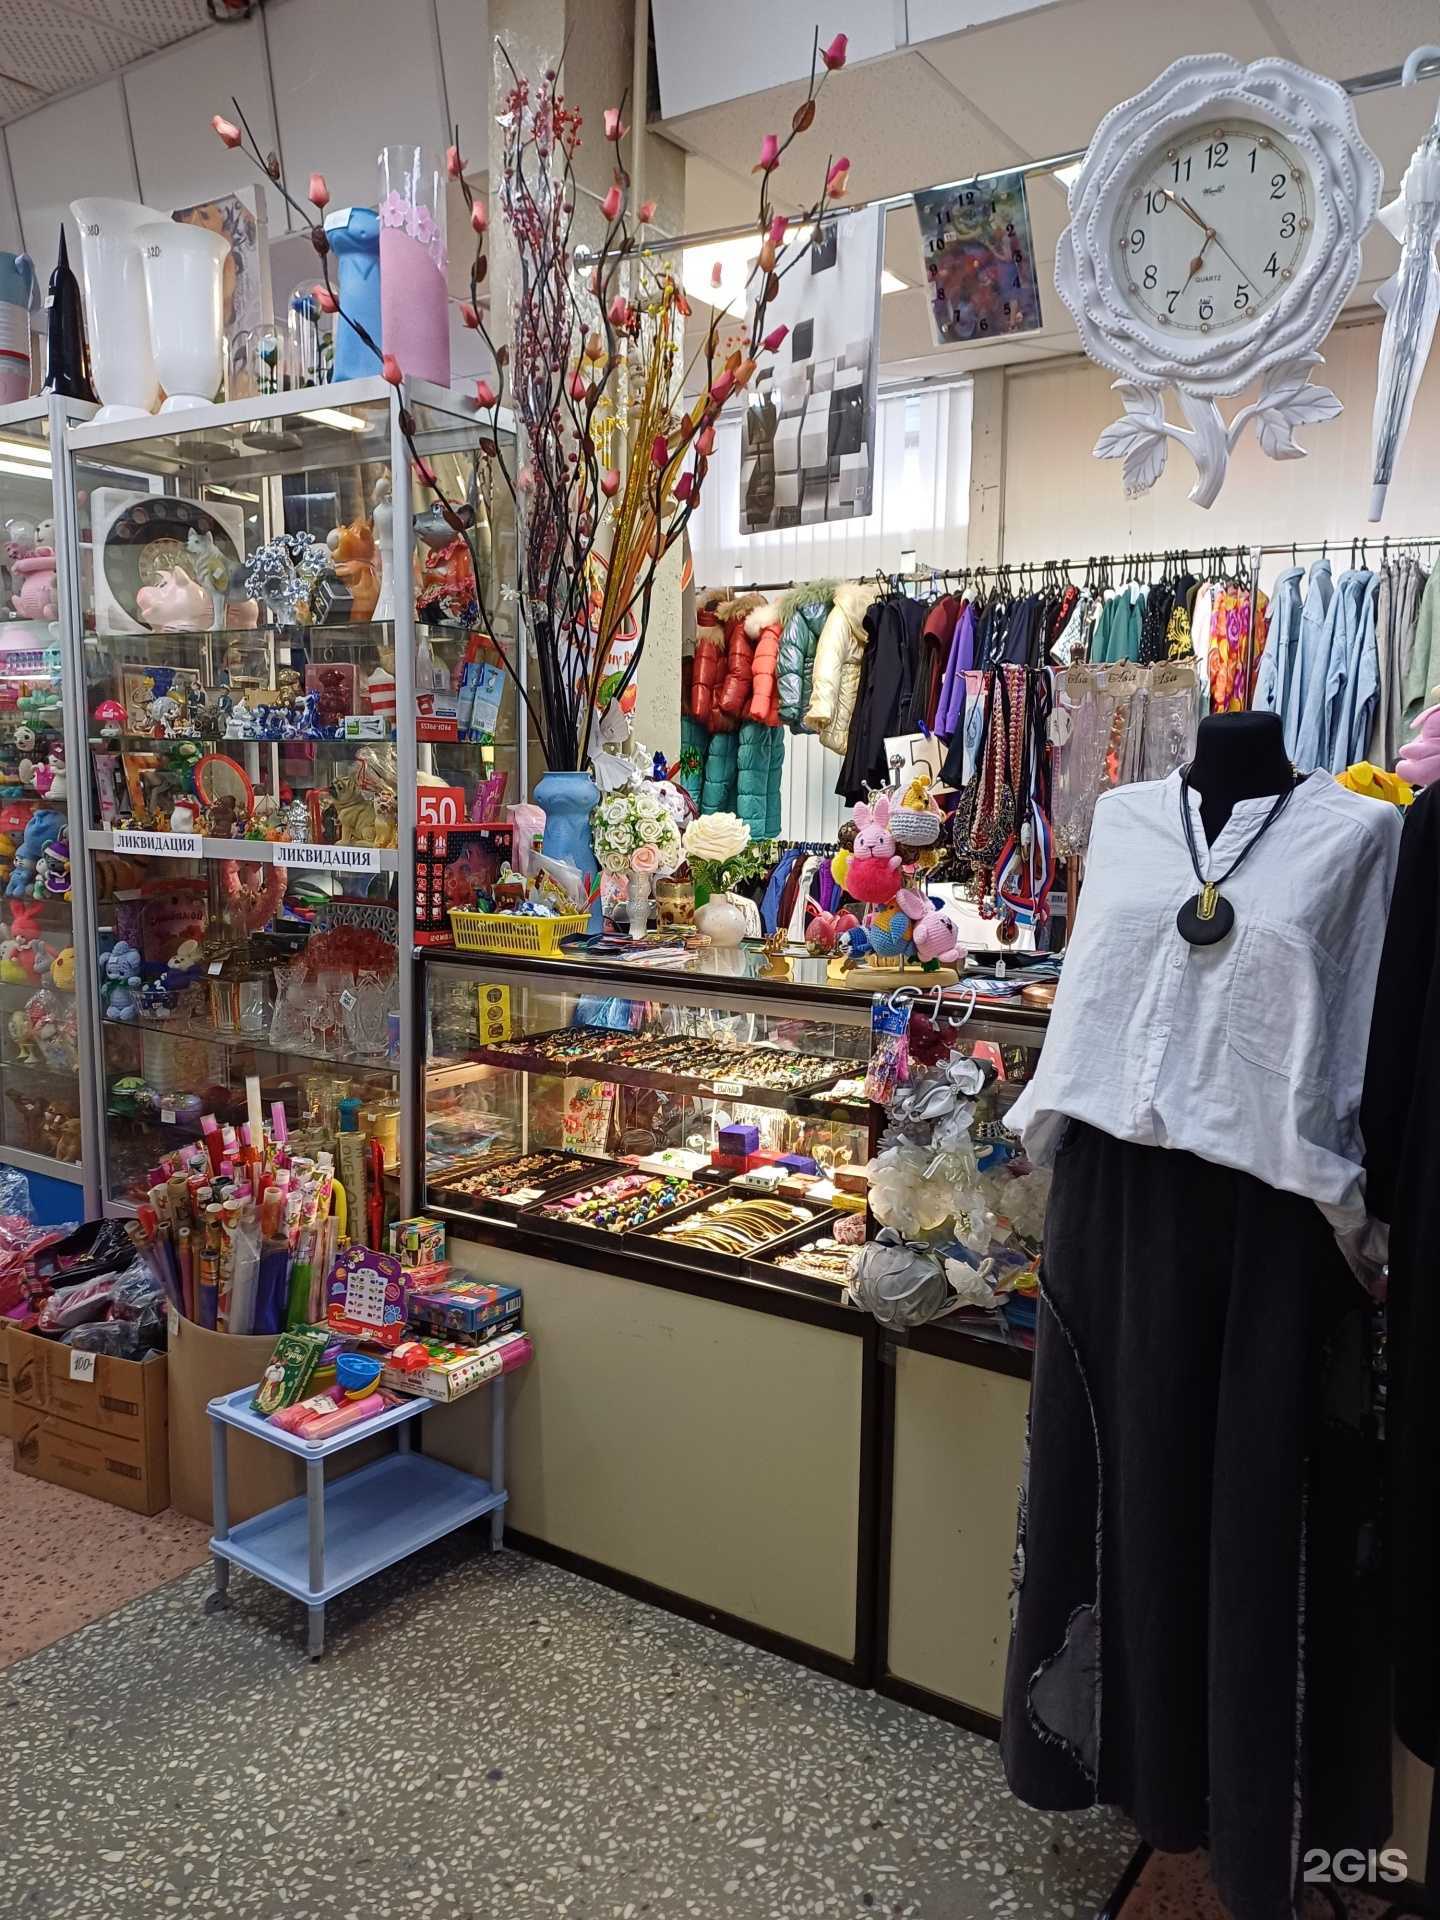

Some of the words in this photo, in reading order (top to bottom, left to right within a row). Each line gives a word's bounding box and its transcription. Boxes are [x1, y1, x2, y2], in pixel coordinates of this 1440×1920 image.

[1205, 142, 1229, 170] 12
[1247, 149, 1257, 174] 1
[1171, 157, 1193, 183] 11
[957, 191, 974, 207] 12
[1269, 173, 1287, 200] 2
[1144, 190, 1168, 214] 10
[936, 211, 952, 225] 11
[1279, 212, 1297, 239] 3
[1006, 224, 1017, 238] 2
[1130, 229, 1146, 254] 9
[928, 239, 945, 253] 10
[1142, 264, 1158, 290] 8
[1264, 251, 1281, 278] 4
[1003, 303, 1012, 315] 5
[1166, 290, 1181, 314] 7
[1199, 295, 1214, 320] 6
[1234, 284, 1250, 309] 5
[979, 319, 989, 331] 6
[419, 797, 457, 824] 50
[117, 835, 195, 852] ЛИКВИДАЦИЯ
[278, 847, 371, 867] ЛИКВИДАЦИЯ
